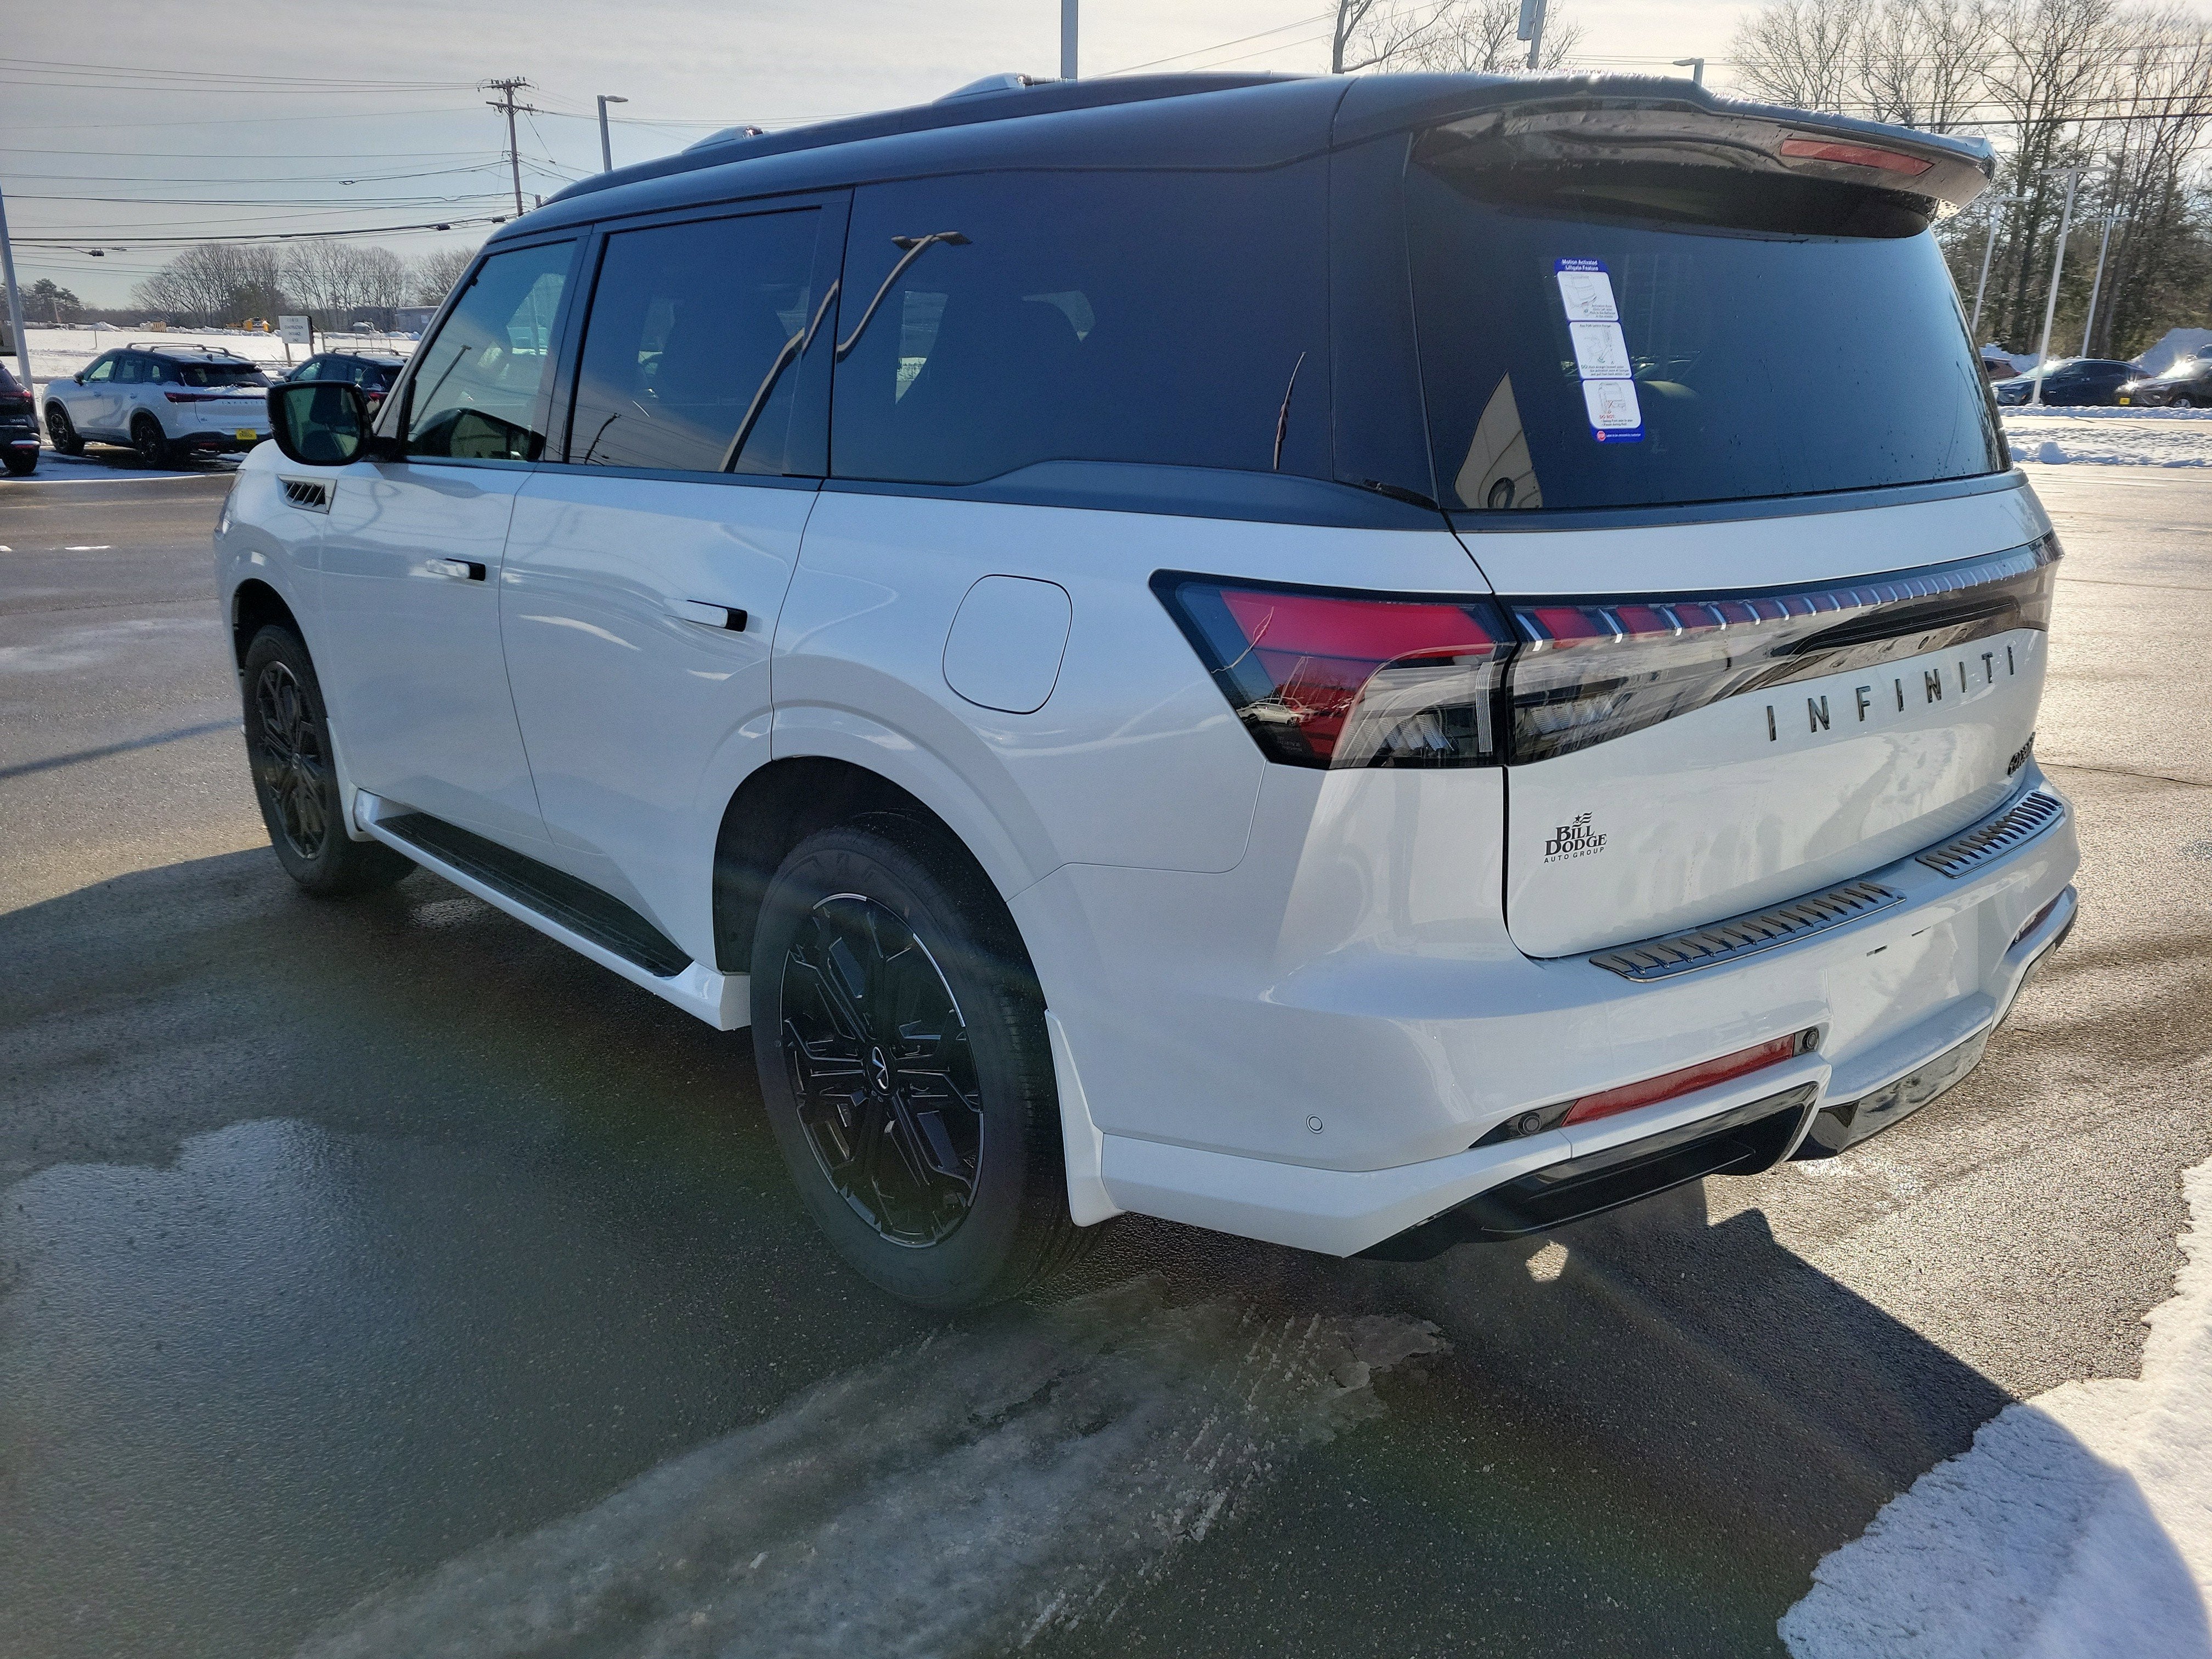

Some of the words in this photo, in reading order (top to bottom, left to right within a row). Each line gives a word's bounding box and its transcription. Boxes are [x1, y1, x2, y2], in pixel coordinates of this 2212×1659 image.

[1766, 645, 2015, 742] INFINITI
[1556, 825, 1595, 842] BILL
[1544, 833, 1607, 856] DODGE
[1544, 854, 1569, 864] AUTO
[1573, 847, 1604, 858] GROUP
